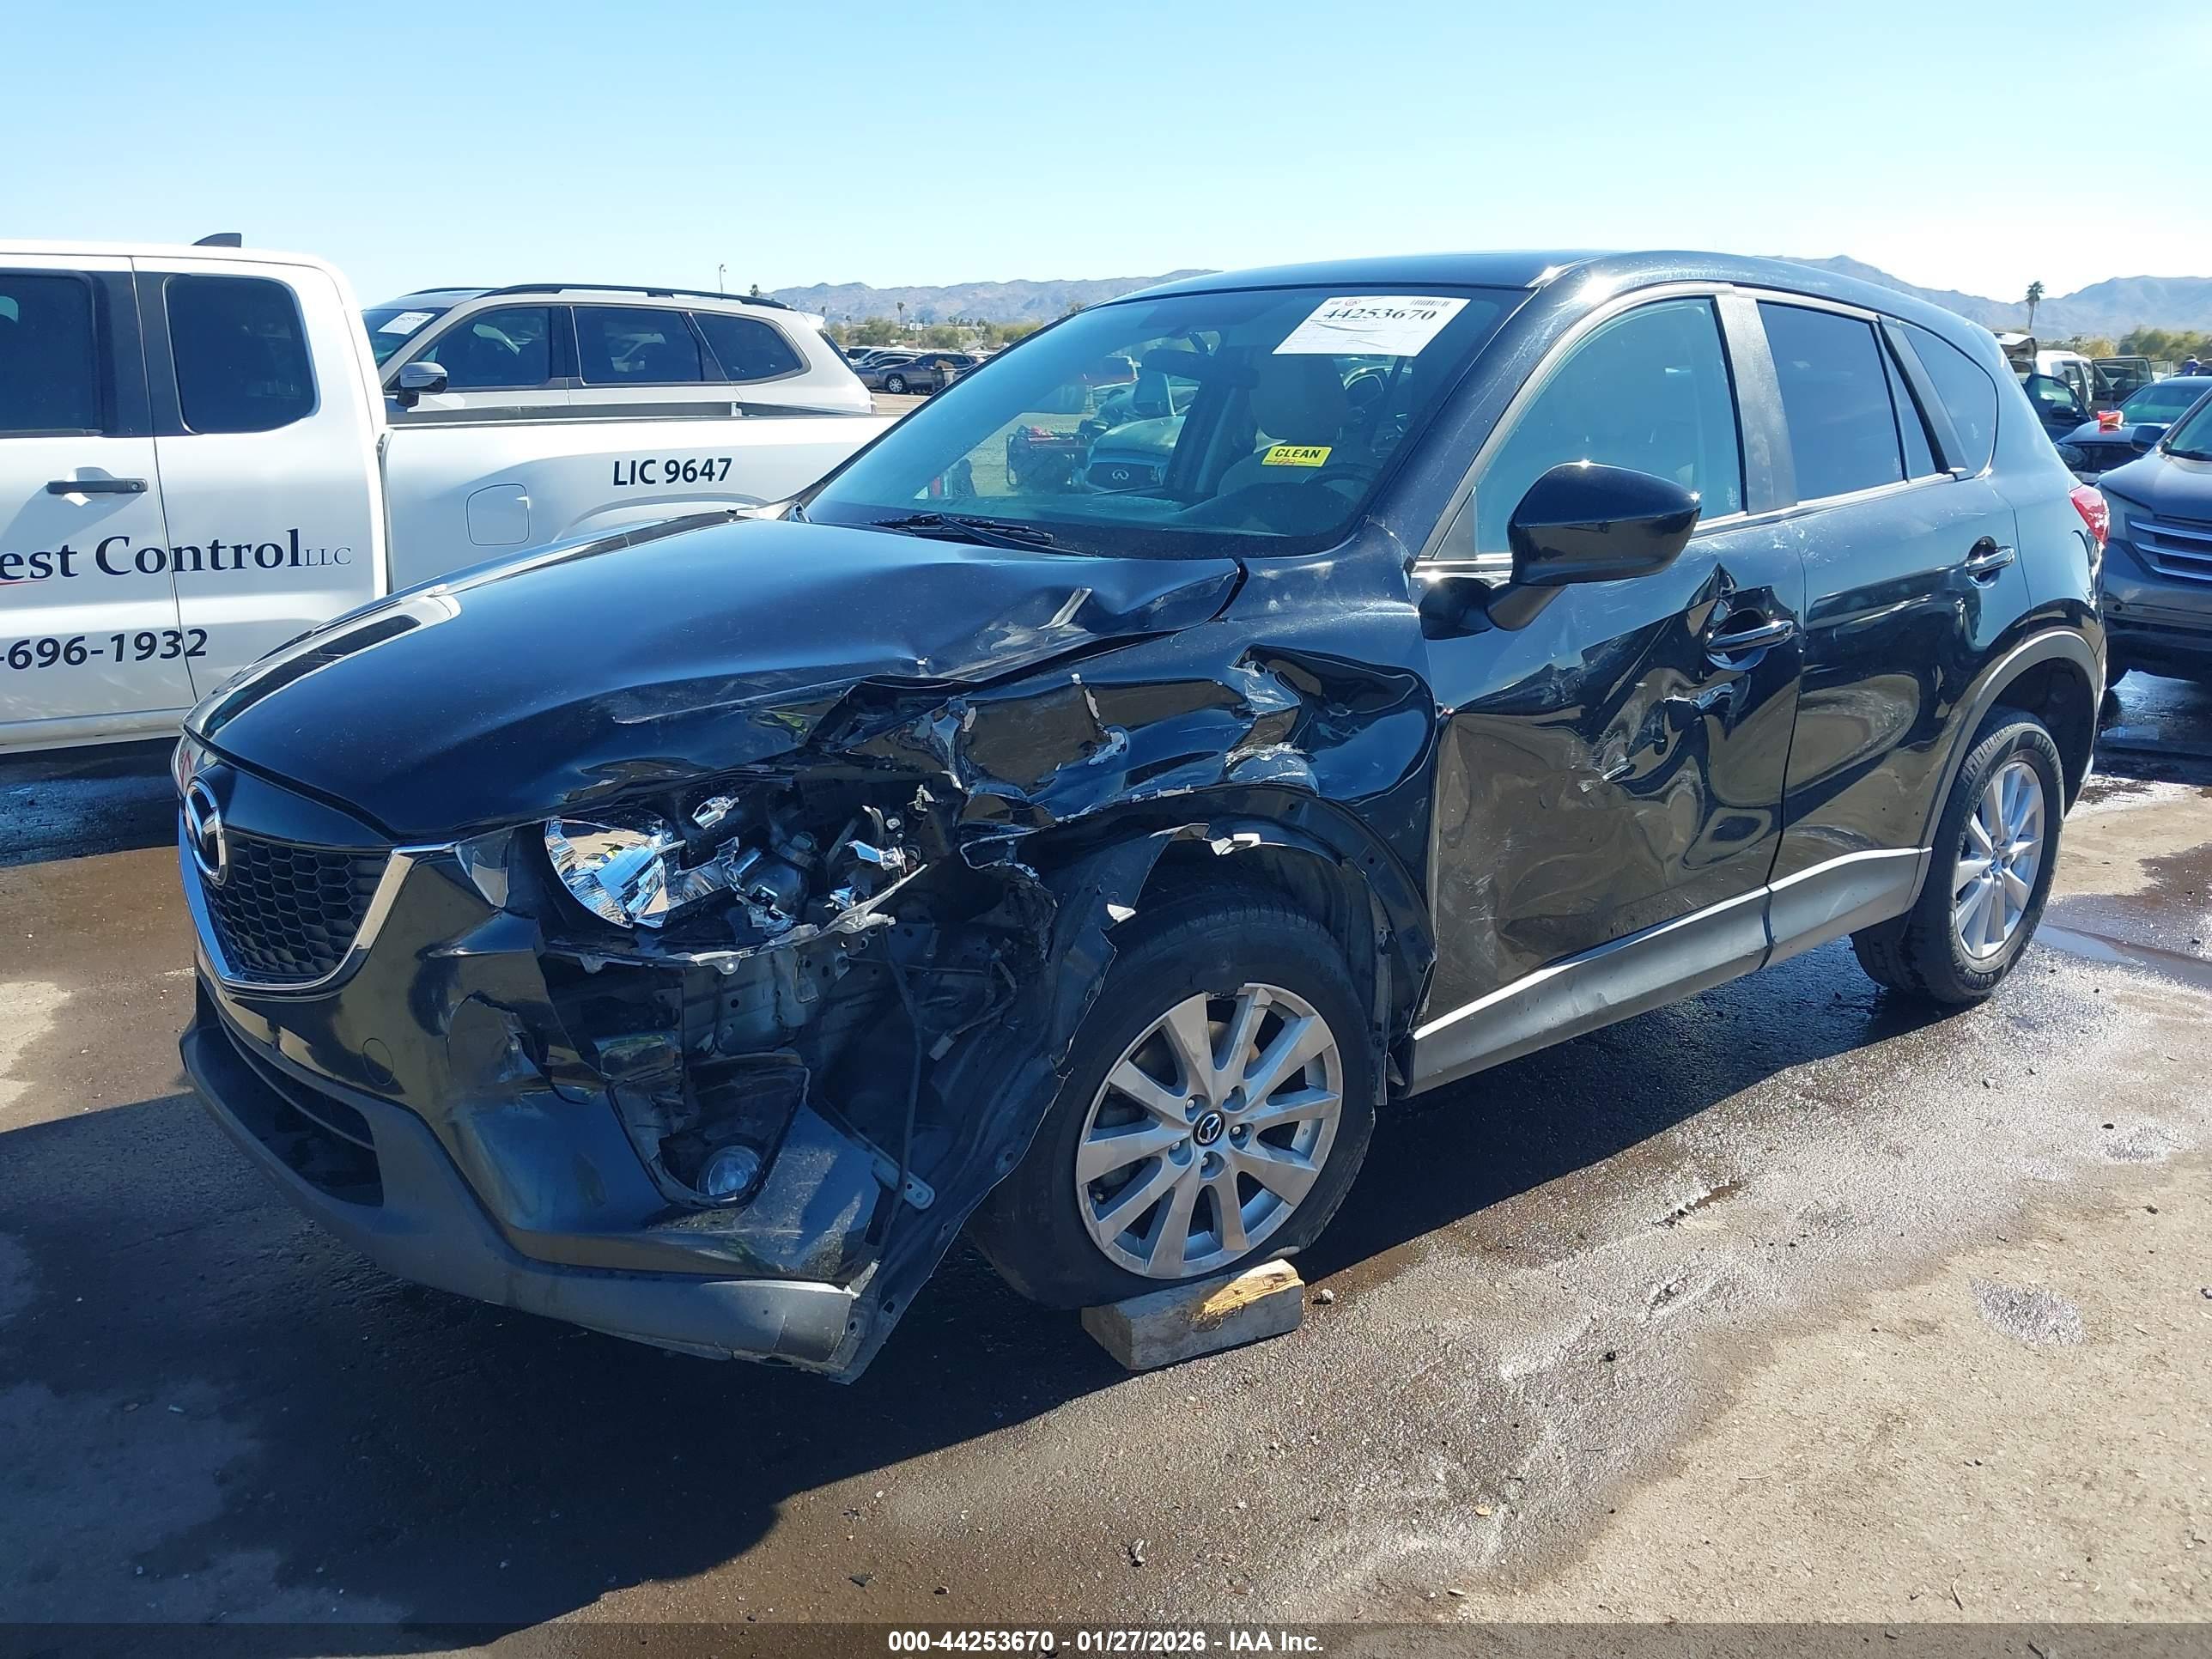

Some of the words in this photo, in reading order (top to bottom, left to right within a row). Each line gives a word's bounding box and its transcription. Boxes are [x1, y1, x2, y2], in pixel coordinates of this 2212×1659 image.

[1323, 308, 1437, 321] 44253670
[1274, 448, 1322, 459] CLEAN
[613, 459, 657, 486] LIC
[665, 458, 732, 484] 9647
[95, 528, 302, 576] Control
[304, 546, 352, 567] LLC
